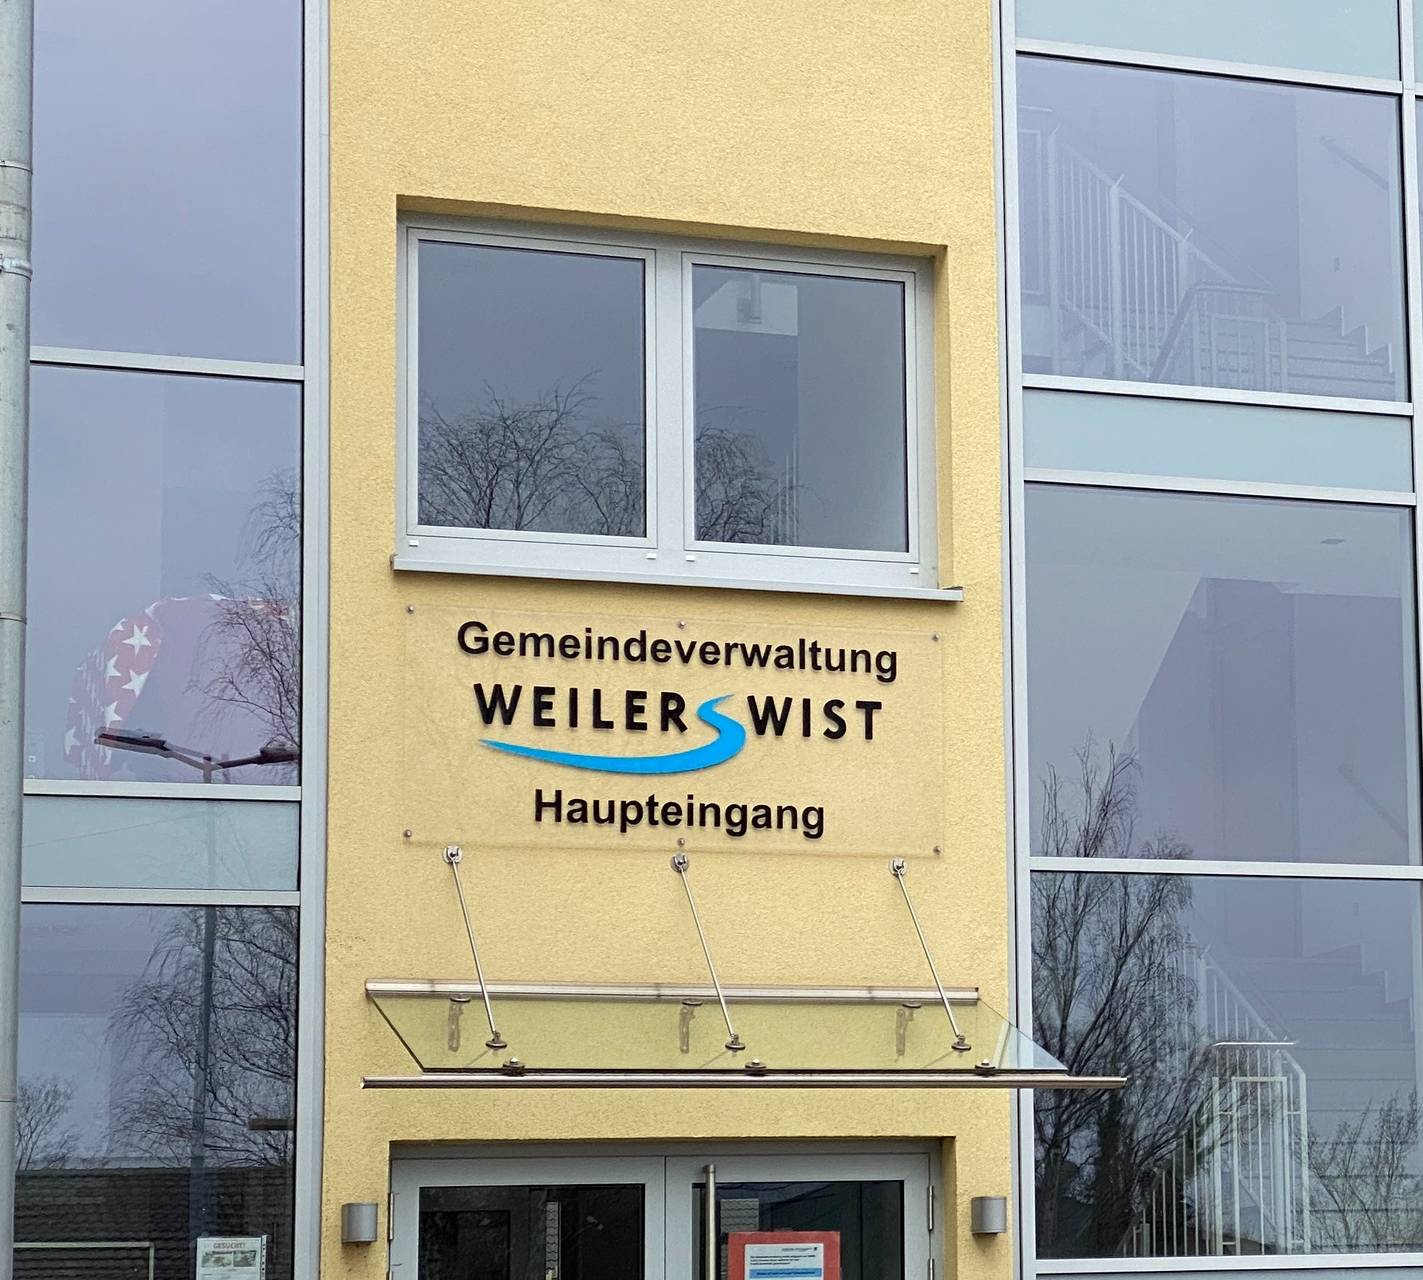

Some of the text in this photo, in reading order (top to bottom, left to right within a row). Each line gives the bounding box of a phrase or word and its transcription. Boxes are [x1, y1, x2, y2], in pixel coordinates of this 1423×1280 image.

[457, 620, 898, 683] Gemeindeverwaltung
[473, 682, 882, 774] WEILERSWIST
[534, 788, 826, 839] Haupteingang
